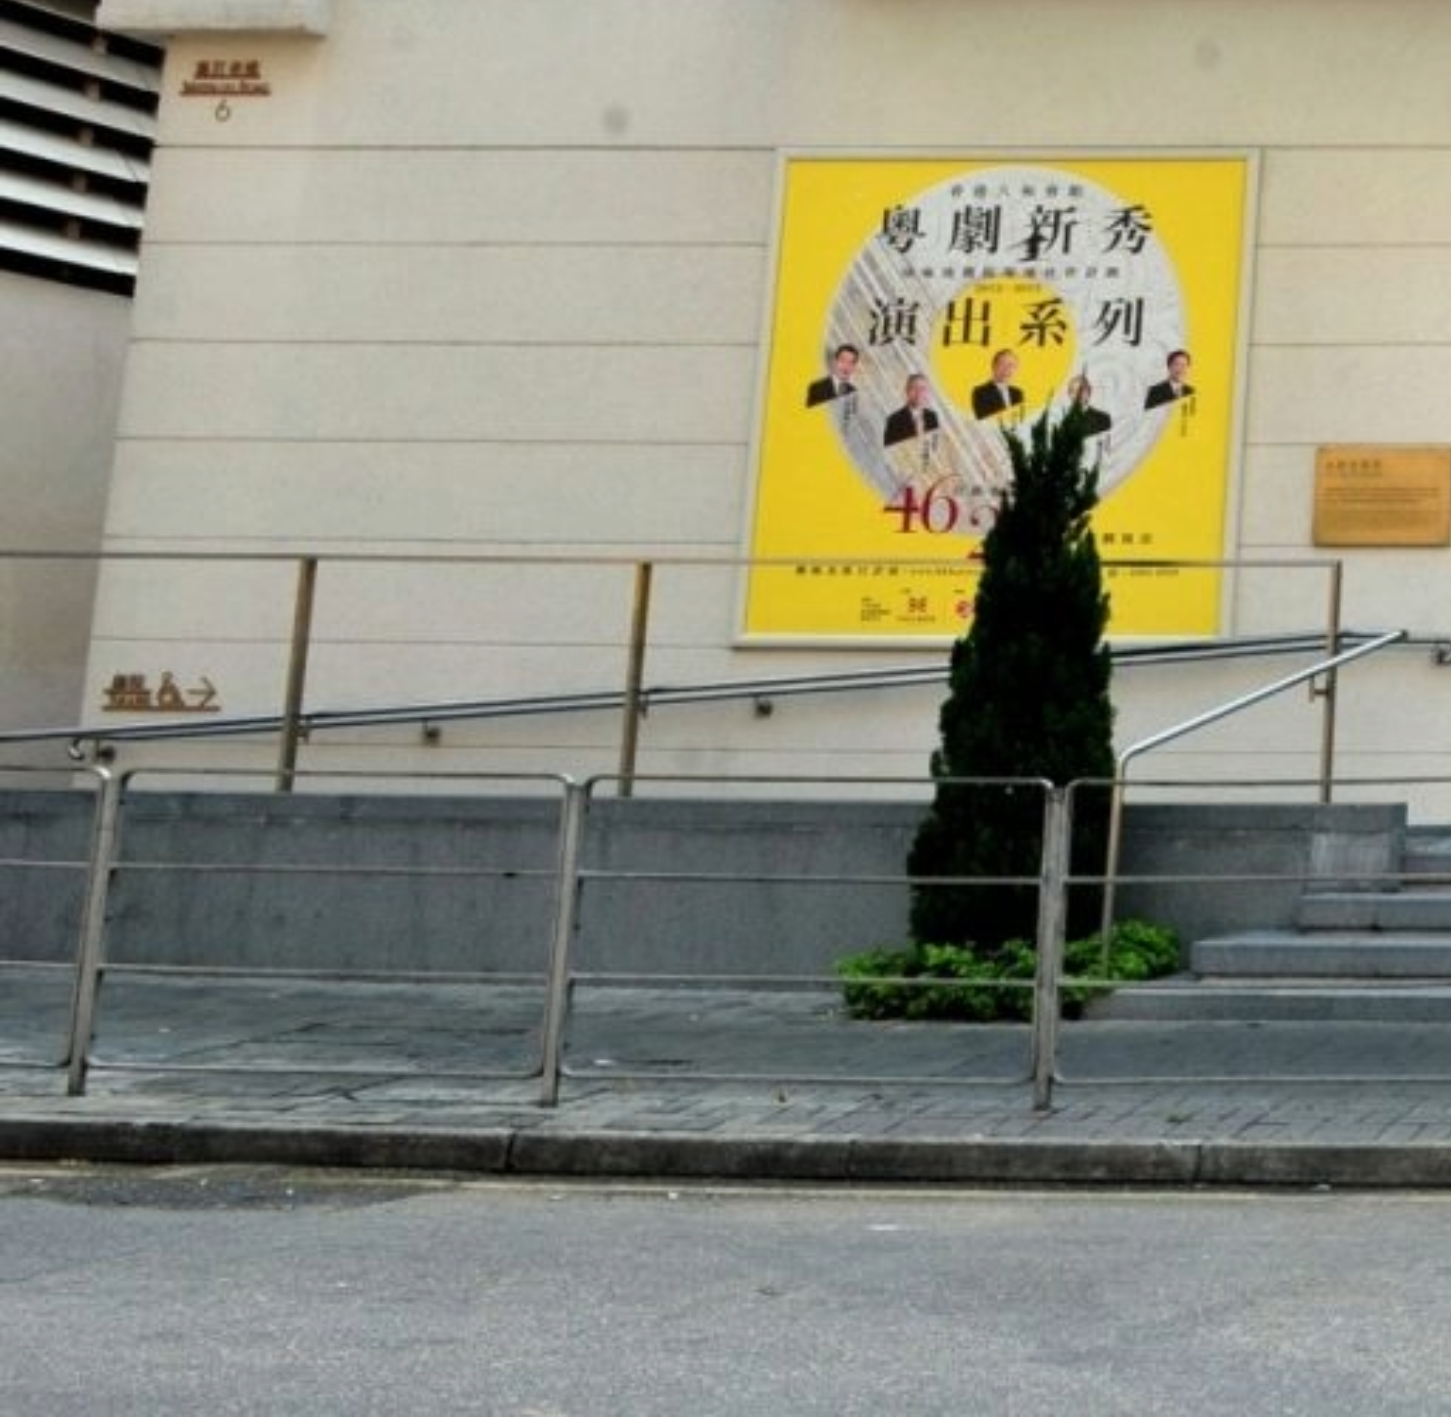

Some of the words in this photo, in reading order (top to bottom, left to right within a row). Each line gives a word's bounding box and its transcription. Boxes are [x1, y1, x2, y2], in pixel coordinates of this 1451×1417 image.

[876, 204, 1152, 261] 粵劇新秀
[868, 297, 1144, 347] 演出系列
